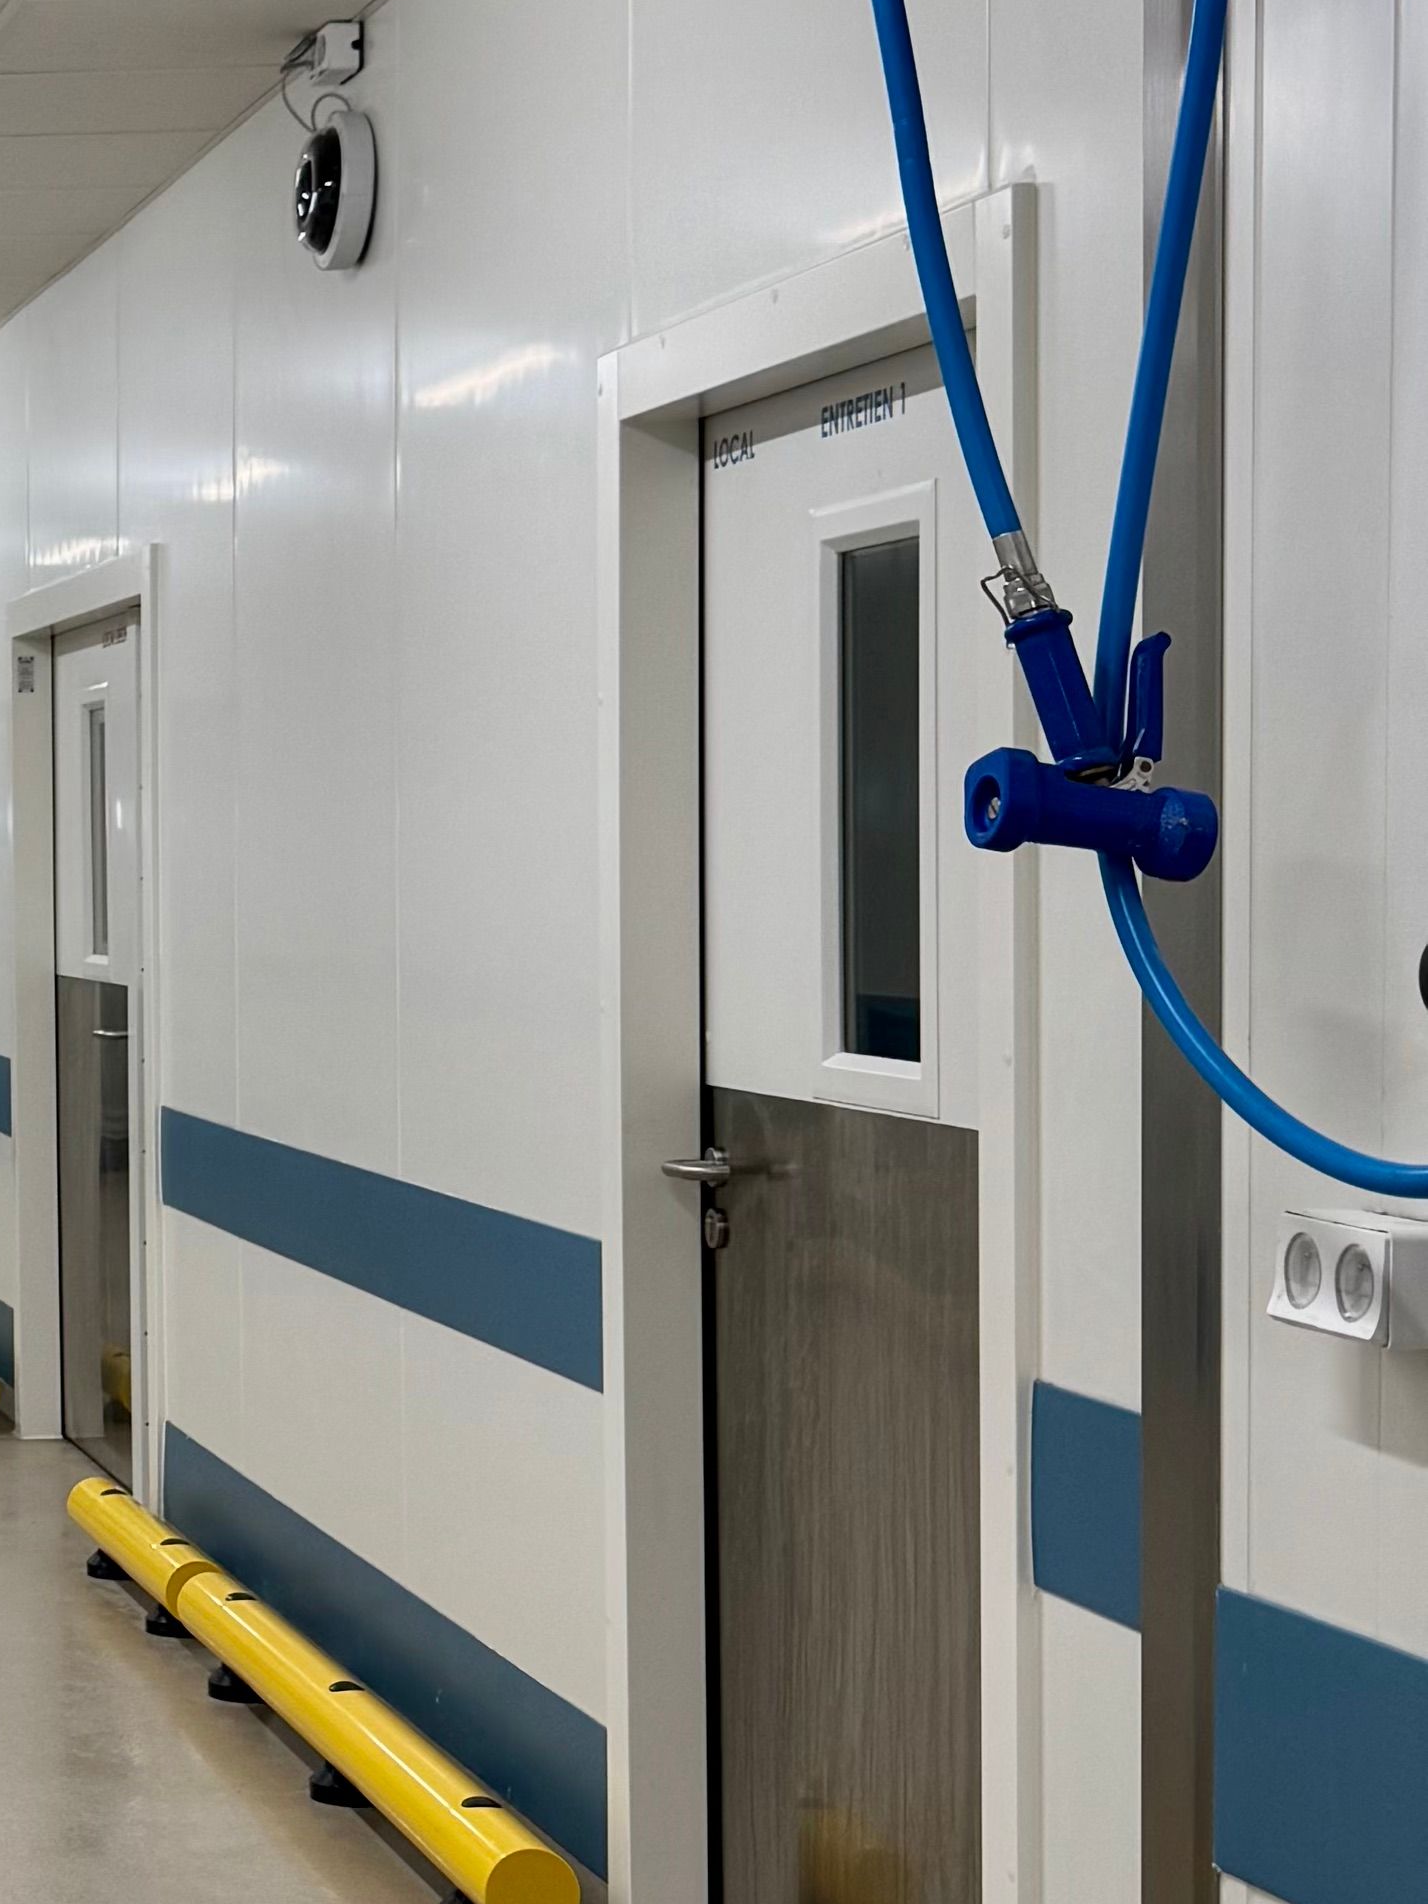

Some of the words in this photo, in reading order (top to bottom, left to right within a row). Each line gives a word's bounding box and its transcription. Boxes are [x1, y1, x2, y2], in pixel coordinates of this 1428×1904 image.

[713, 429, 755, 470] LOCAL
[821, 385, 894, 439] ENTRETIEN
[901, 381, 907, 415] 1
